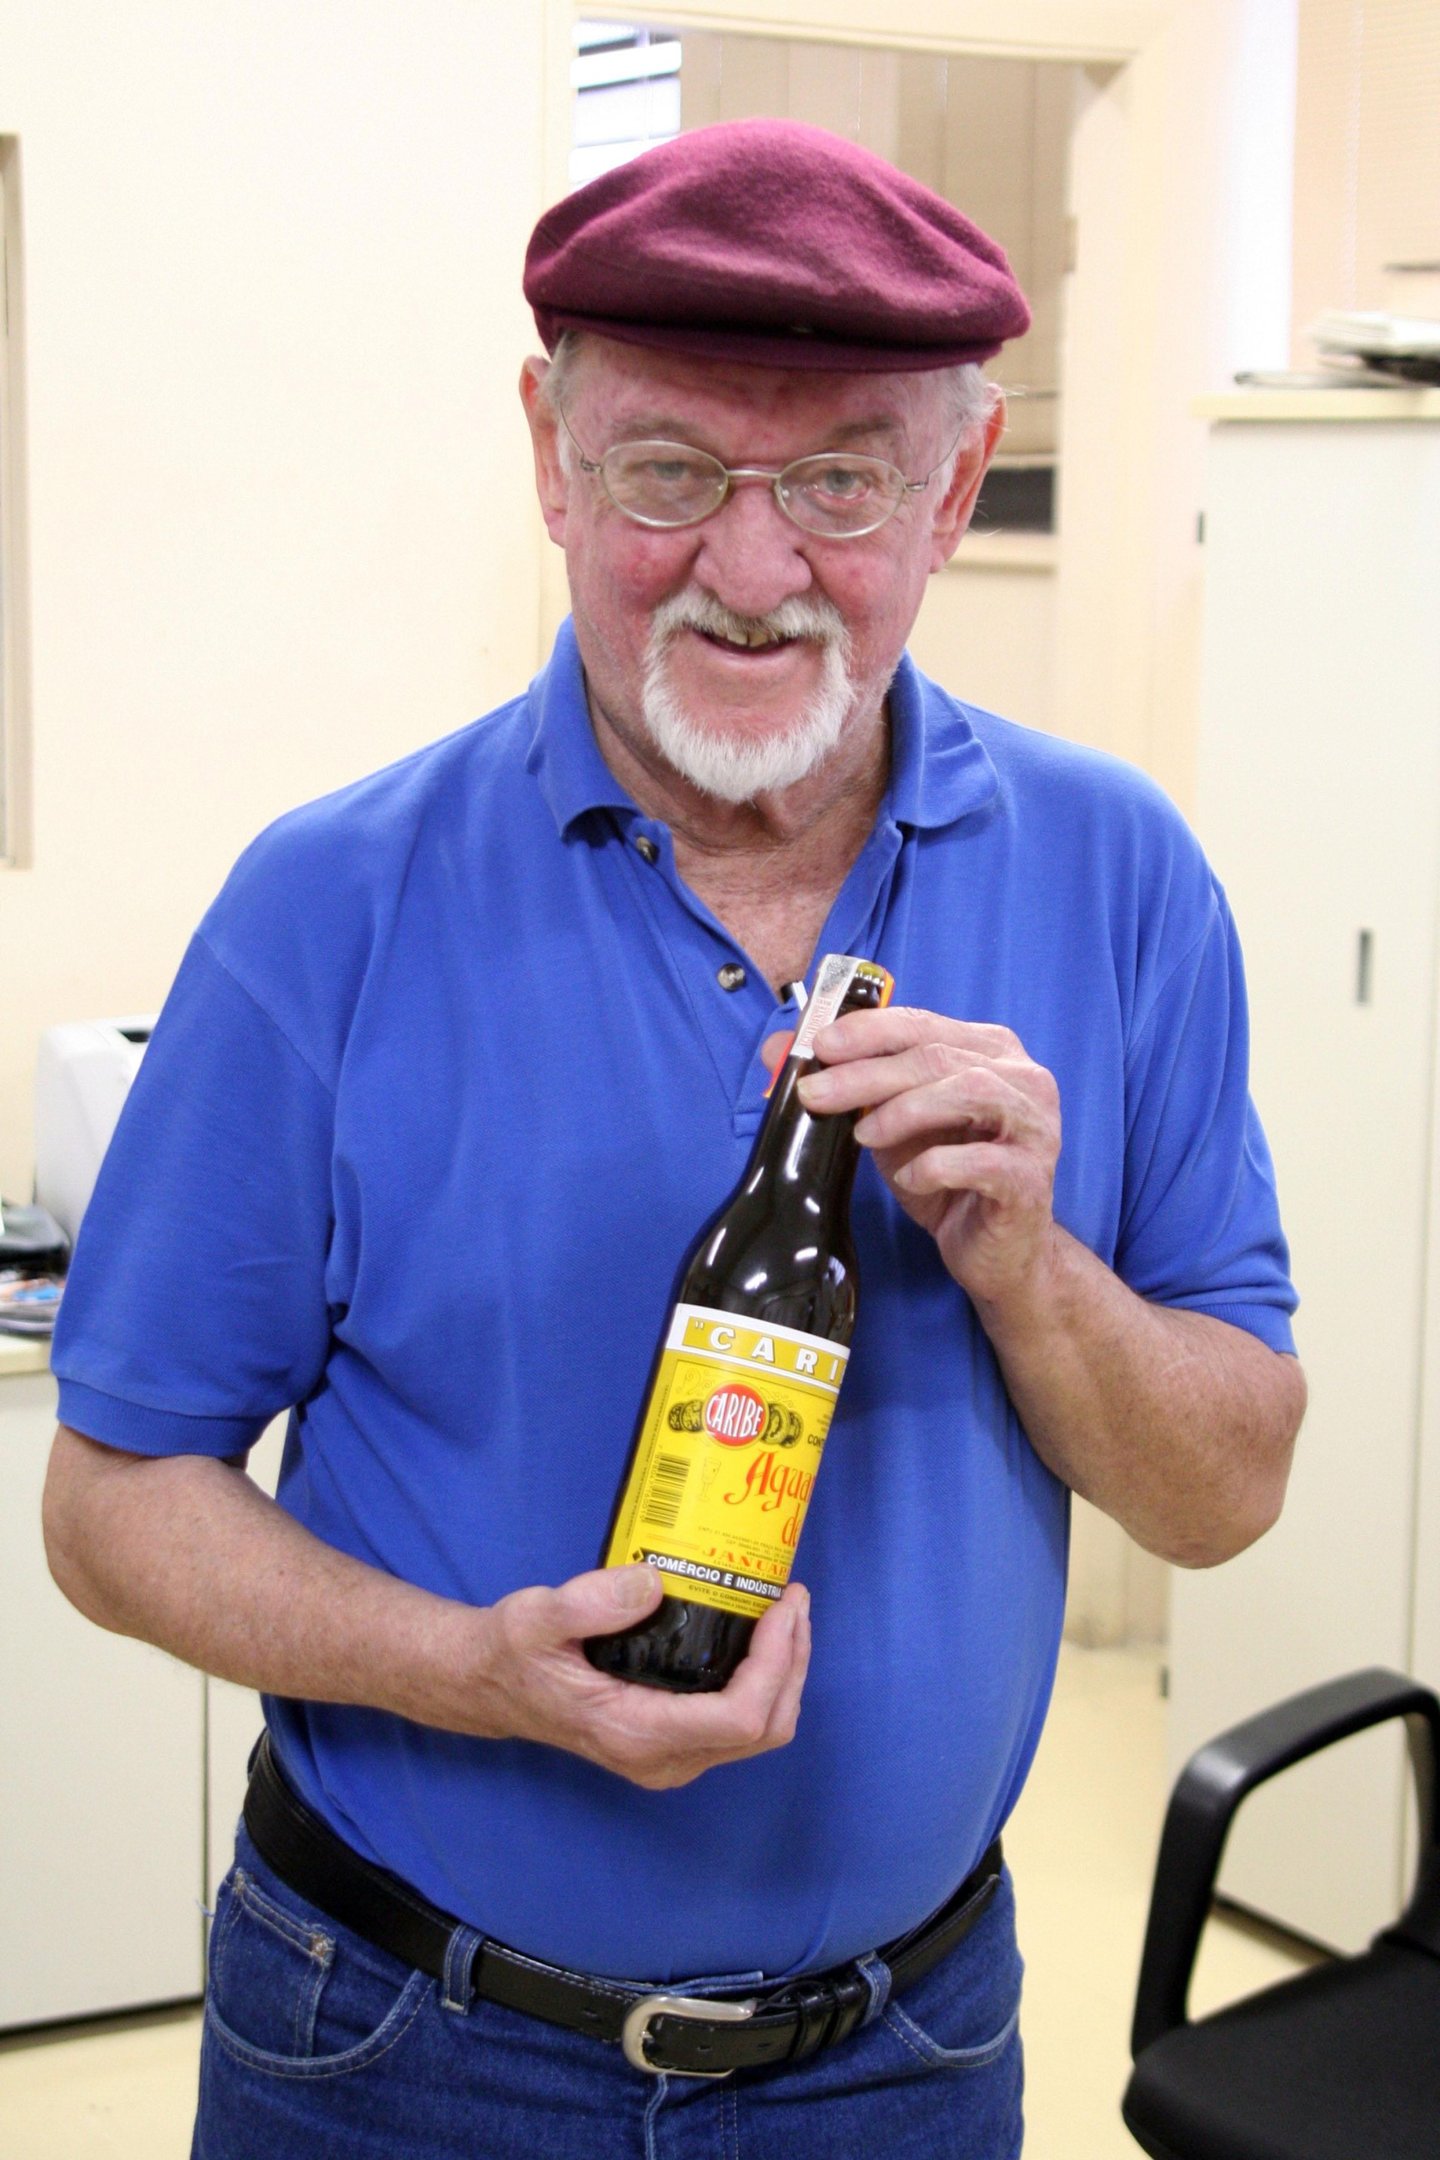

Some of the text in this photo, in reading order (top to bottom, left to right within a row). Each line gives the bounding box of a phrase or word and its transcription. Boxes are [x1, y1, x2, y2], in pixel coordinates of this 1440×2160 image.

[695, 1321, 847, 1384] "CARI
[706, 1392, 763, 1438] CARIBE
[723, 1448, 816, 1512] Agua
[647, 1553, 720, 1582] COMÉRCIO
[724, 1573, 734, 1586] E
